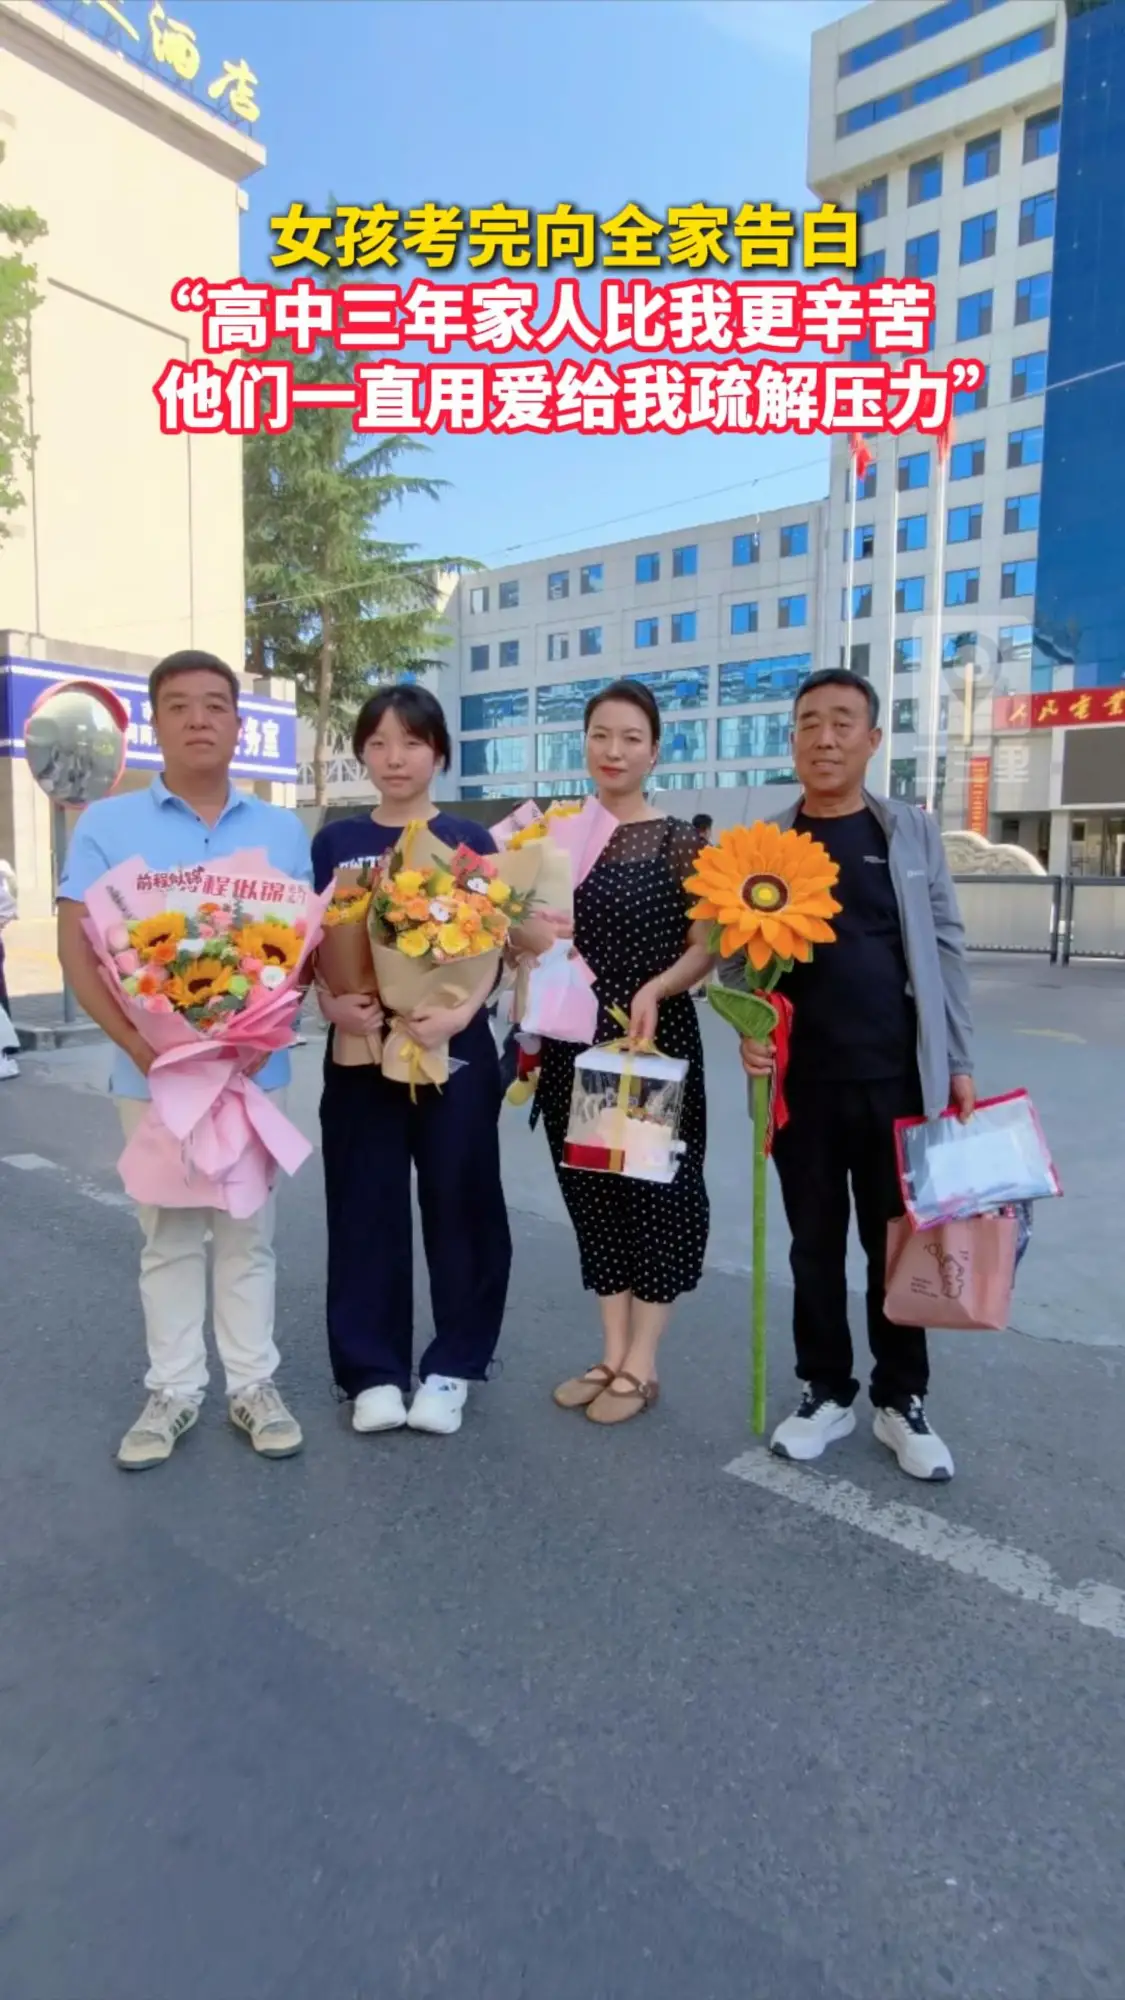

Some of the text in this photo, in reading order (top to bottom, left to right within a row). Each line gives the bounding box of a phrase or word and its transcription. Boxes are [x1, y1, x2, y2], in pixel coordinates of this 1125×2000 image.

[82, 0, 260, 122] 酒店
[235, 716, 281, 759] 务室
[181, 874, 286, 903] 程似锦
